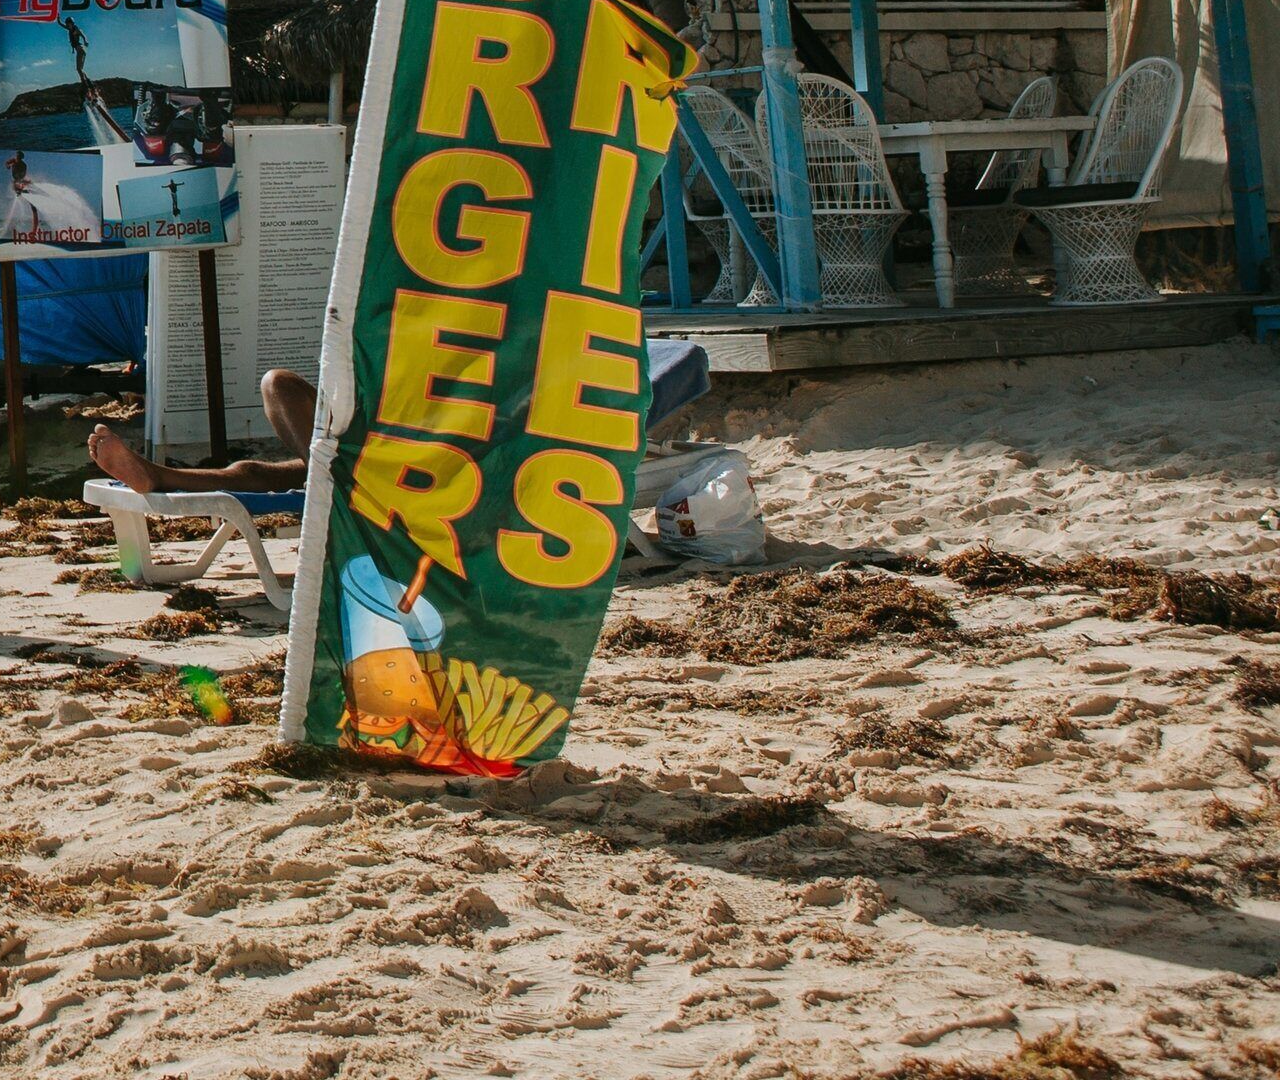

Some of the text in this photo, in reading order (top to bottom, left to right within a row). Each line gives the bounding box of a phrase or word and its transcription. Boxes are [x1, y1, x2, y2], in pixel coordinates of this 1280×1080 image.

[13, 219, 211, 245] Instructor Oficial Zapata
